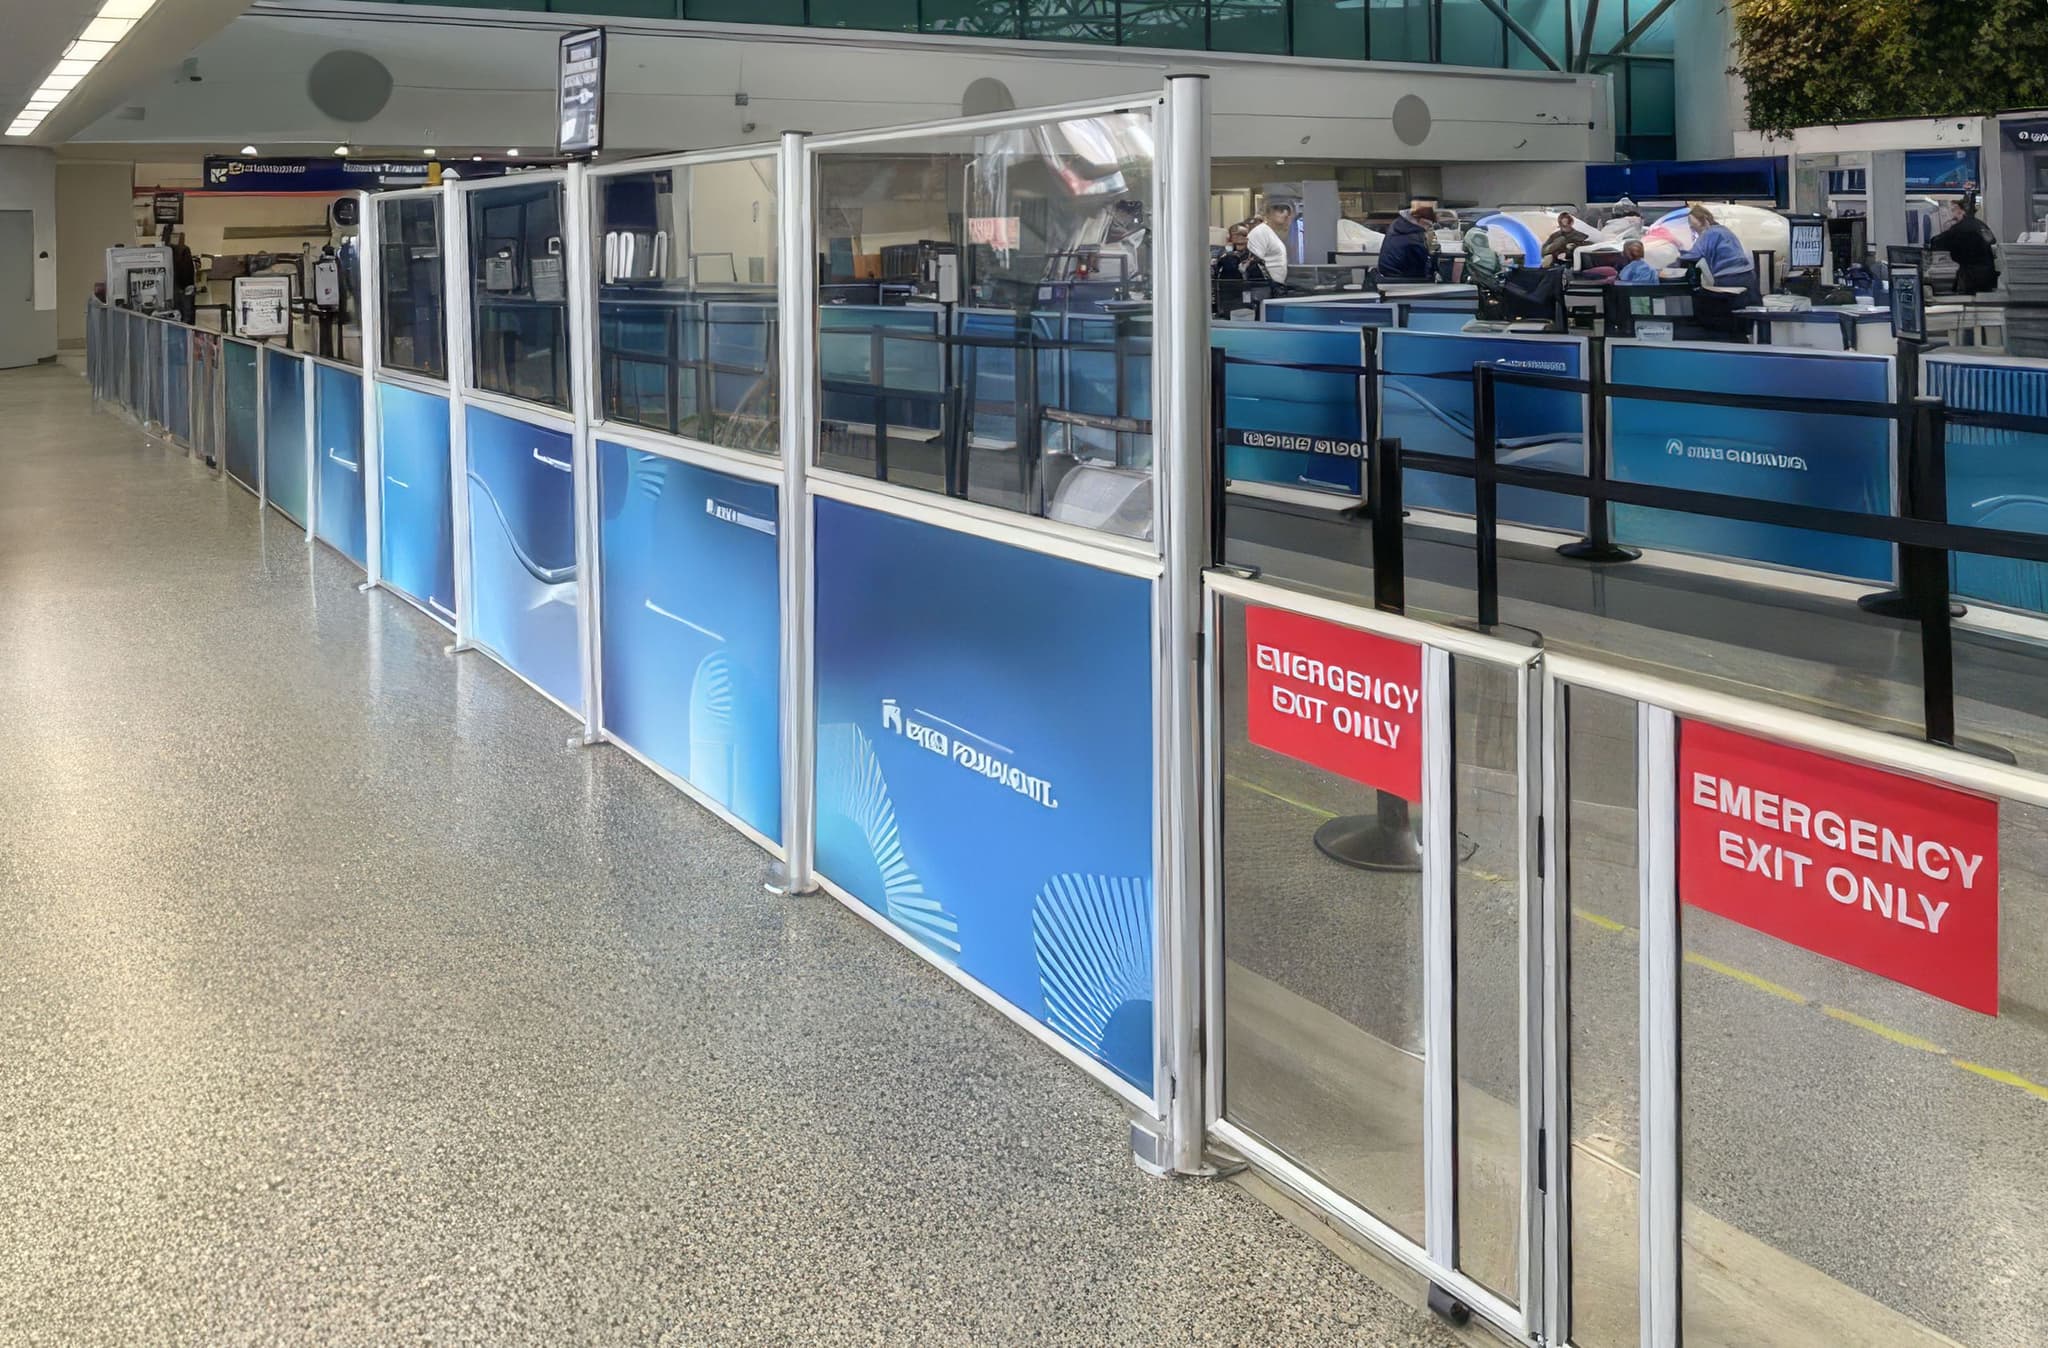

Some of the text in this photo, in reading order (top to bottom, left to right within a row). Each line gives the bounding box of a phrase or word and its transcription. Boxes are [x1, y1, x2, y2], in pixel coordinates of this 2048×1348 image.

[1693, 772, 1983, 889] EMERGENCY
[1719, 830, 1950, 933] EXIT ONLY
